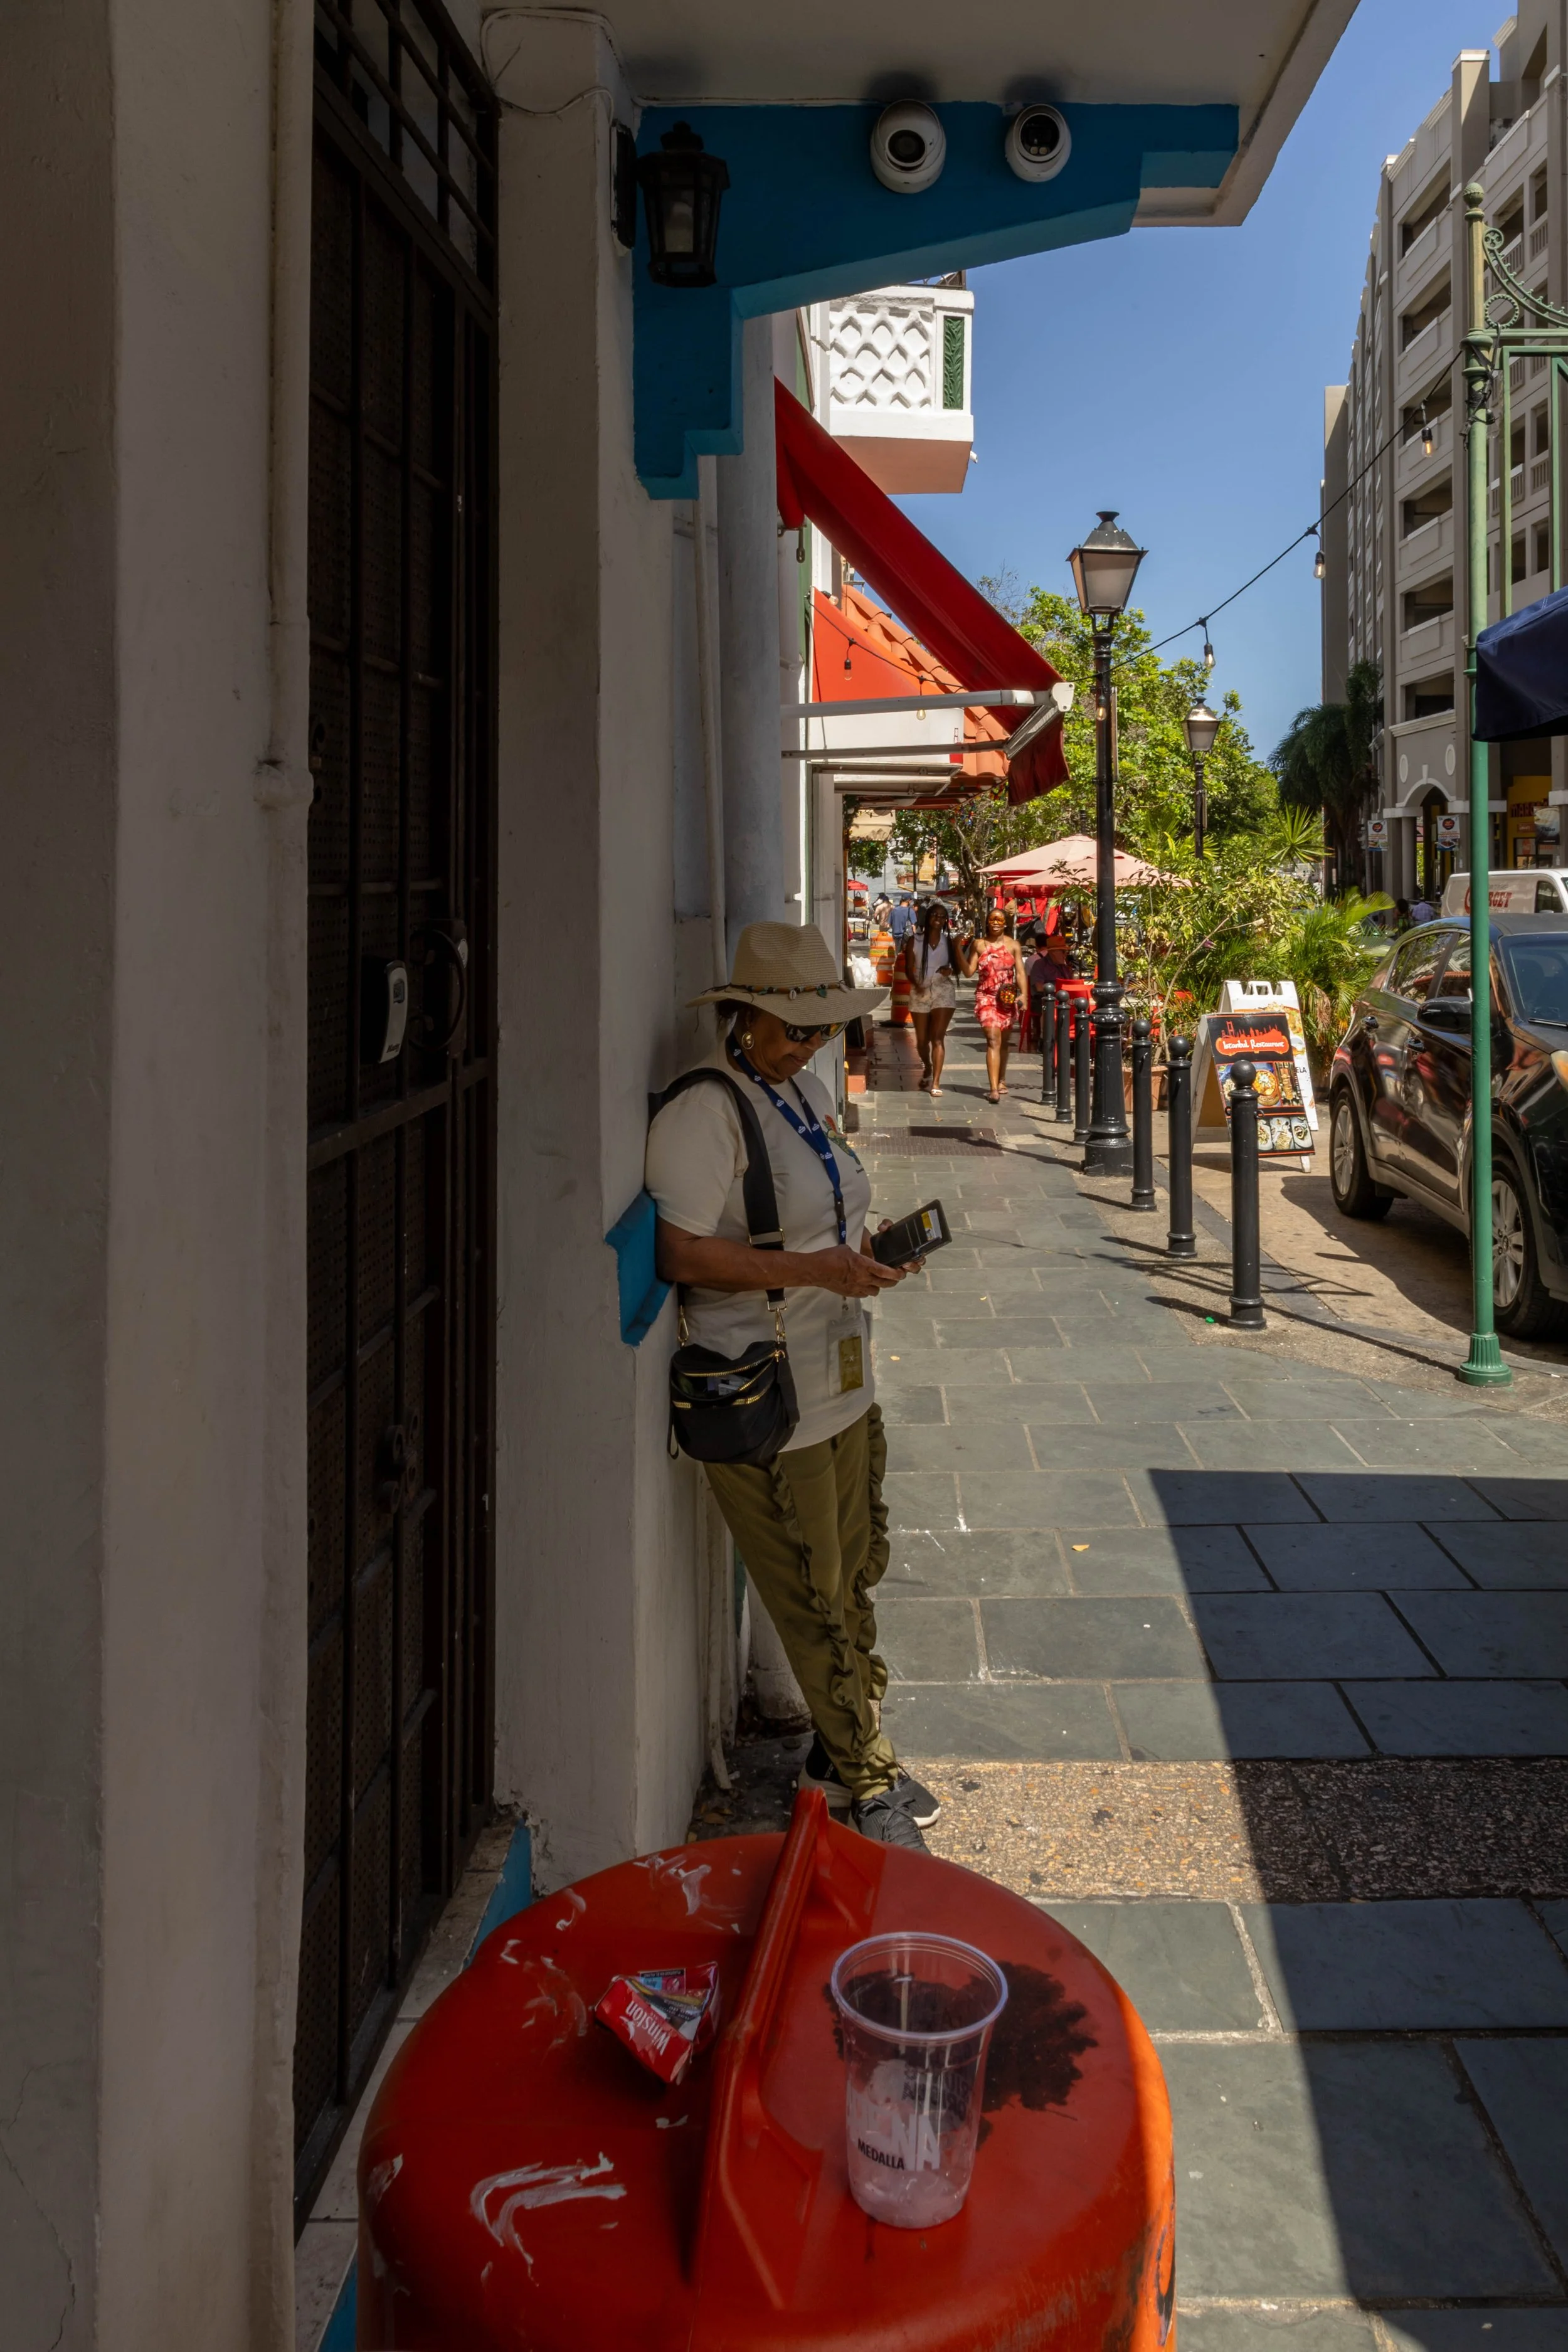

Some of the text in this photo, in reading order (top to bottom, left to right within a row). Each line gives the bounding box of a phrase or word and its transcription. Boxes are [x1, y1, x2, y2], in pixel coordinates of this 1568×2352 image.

[1223, 1039, 1285, 1049] Istanbul Restaurant
[625, 2000, 670, 2056] Winston
[857, 2137, 904, 2171] MEDALLA
